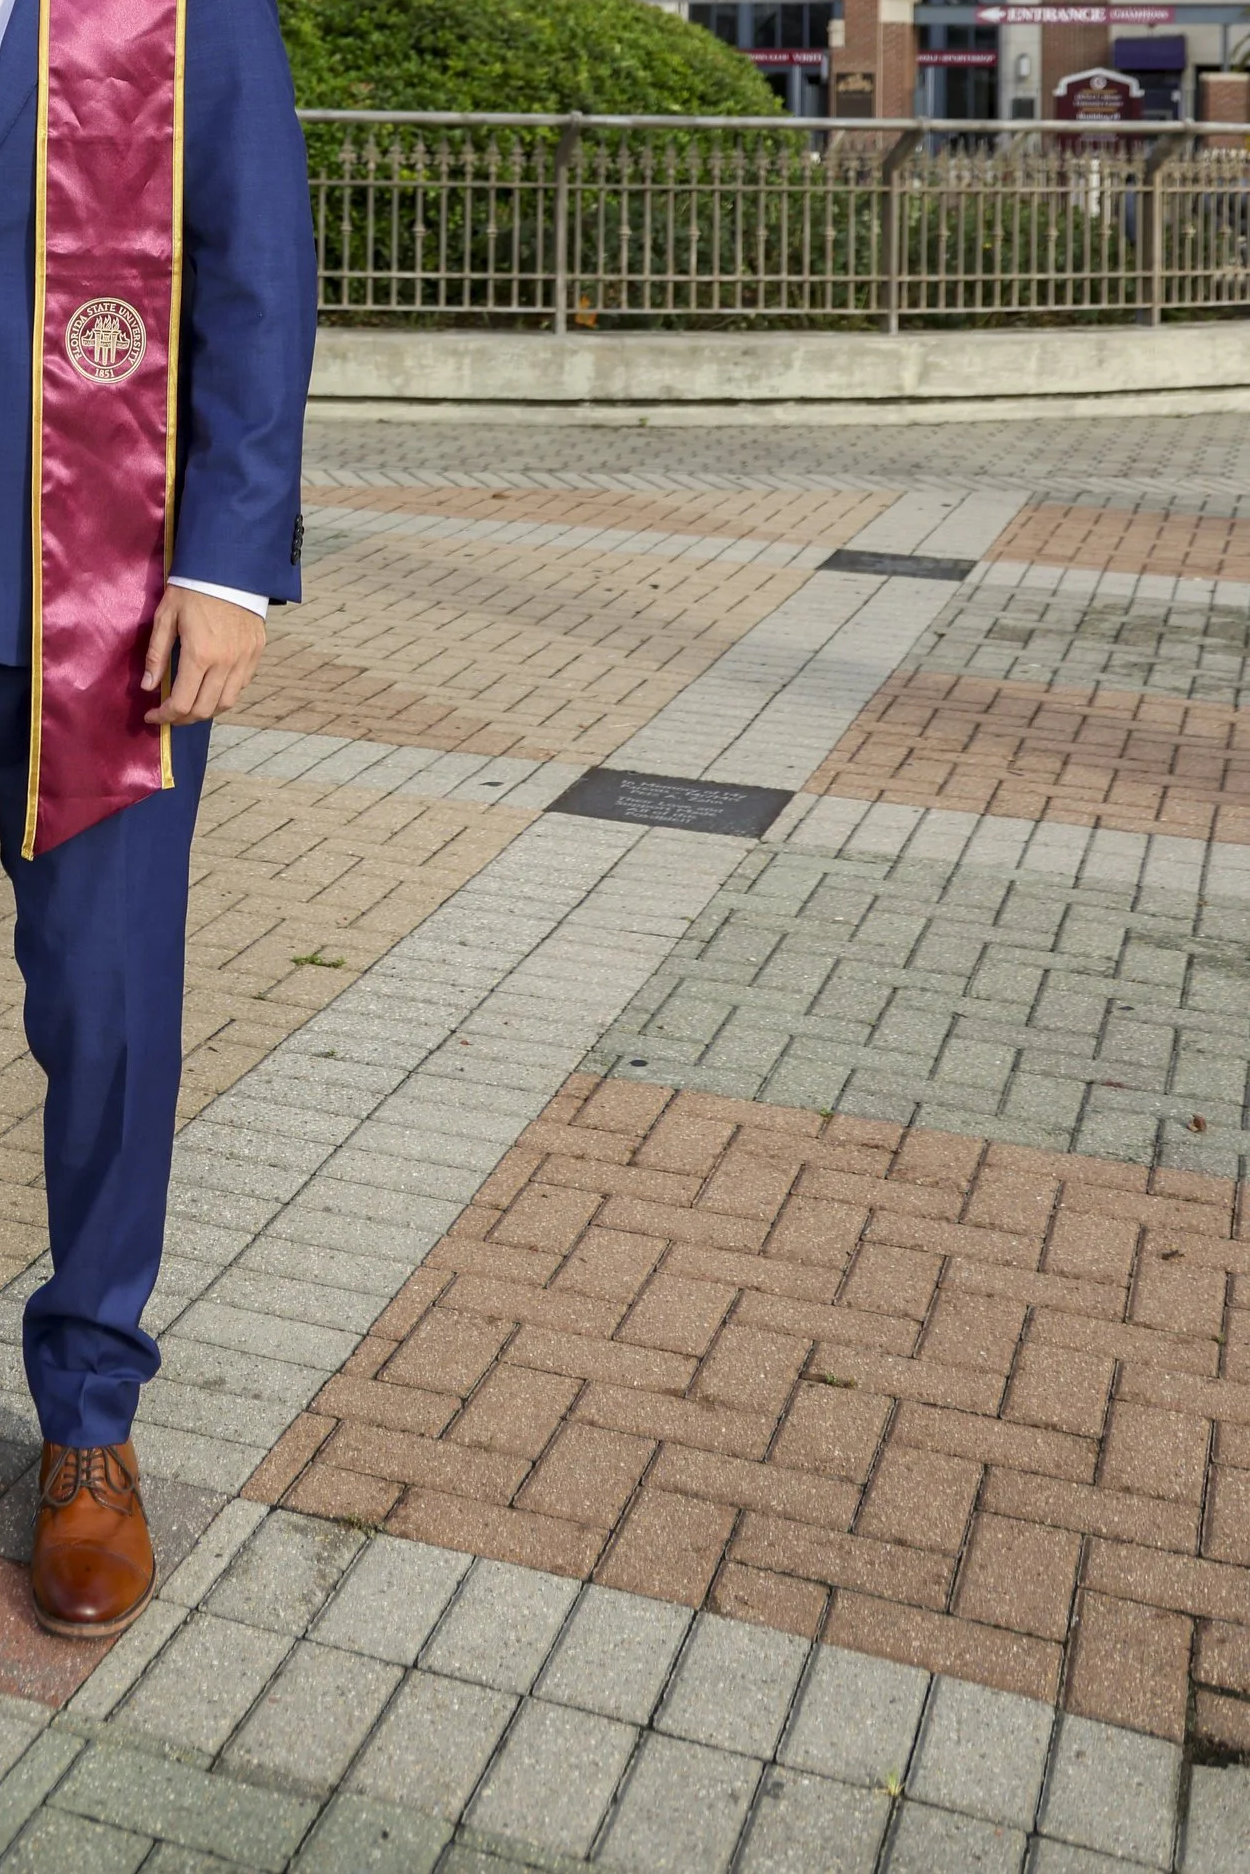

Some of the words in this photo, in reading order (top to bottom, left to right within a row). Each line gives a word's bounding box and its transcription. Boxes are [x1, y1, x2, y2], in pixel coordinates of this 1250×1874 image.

[1006, 6, 1107, 23] ENTRANCE
[70, 315, 88, 361] FLORIDA
[87, 302, 117, 316] STATE
[118, 307, 141, 366] UNIVERSITY
[94, 368, 115, 379] 1851
